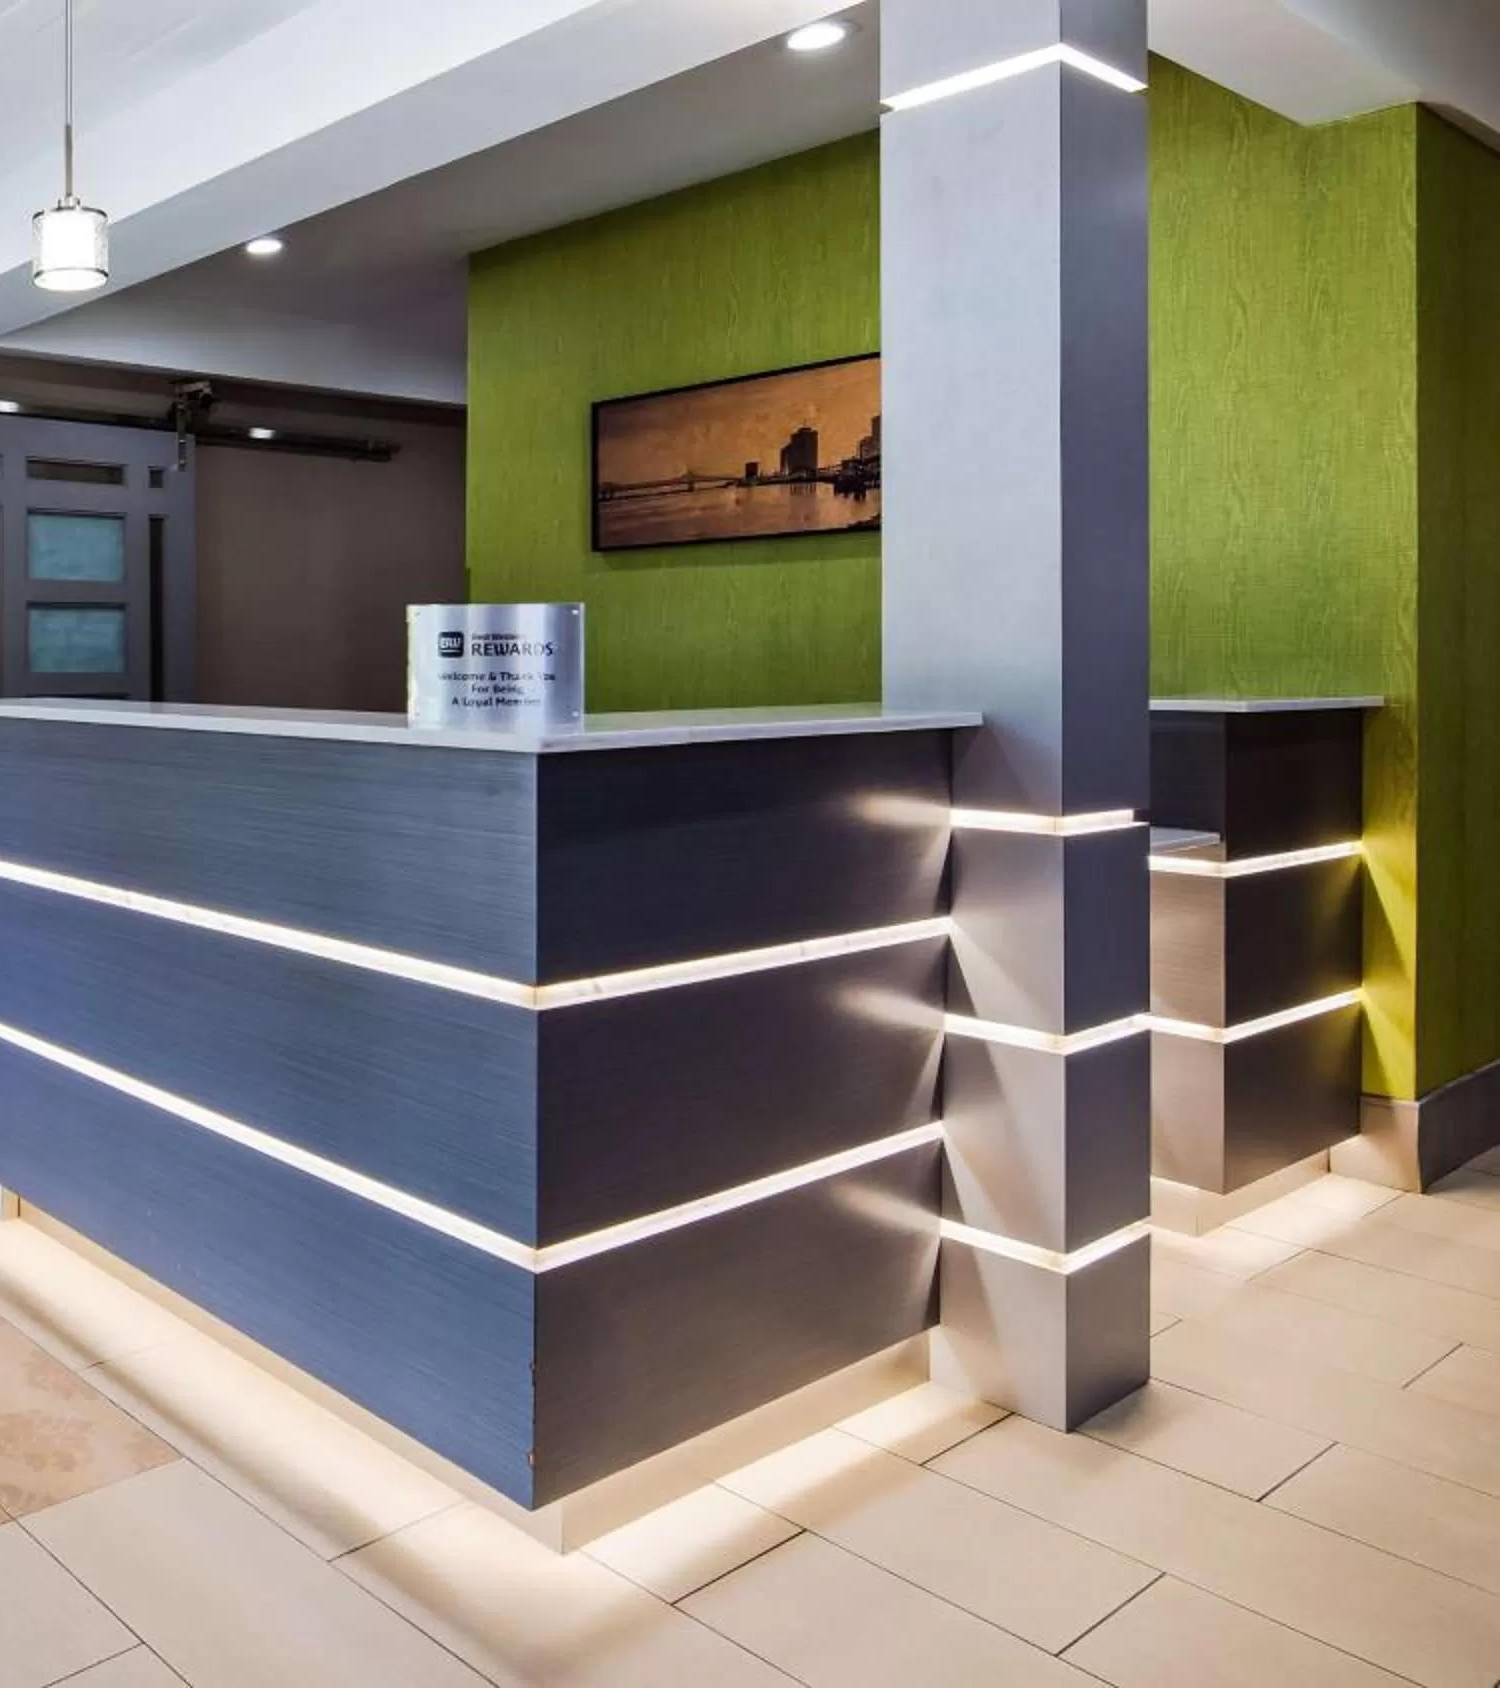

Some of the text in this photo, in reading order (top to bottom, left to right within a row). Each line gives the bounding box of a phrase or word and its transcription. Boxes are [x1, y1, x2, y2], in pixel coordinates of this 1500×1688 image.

[471, 641, 554, 657] REWARDS
[471, 685, 489, 694] For
[451, 697, 460, 706] A
[463, 696, 492, 708] Loyal
